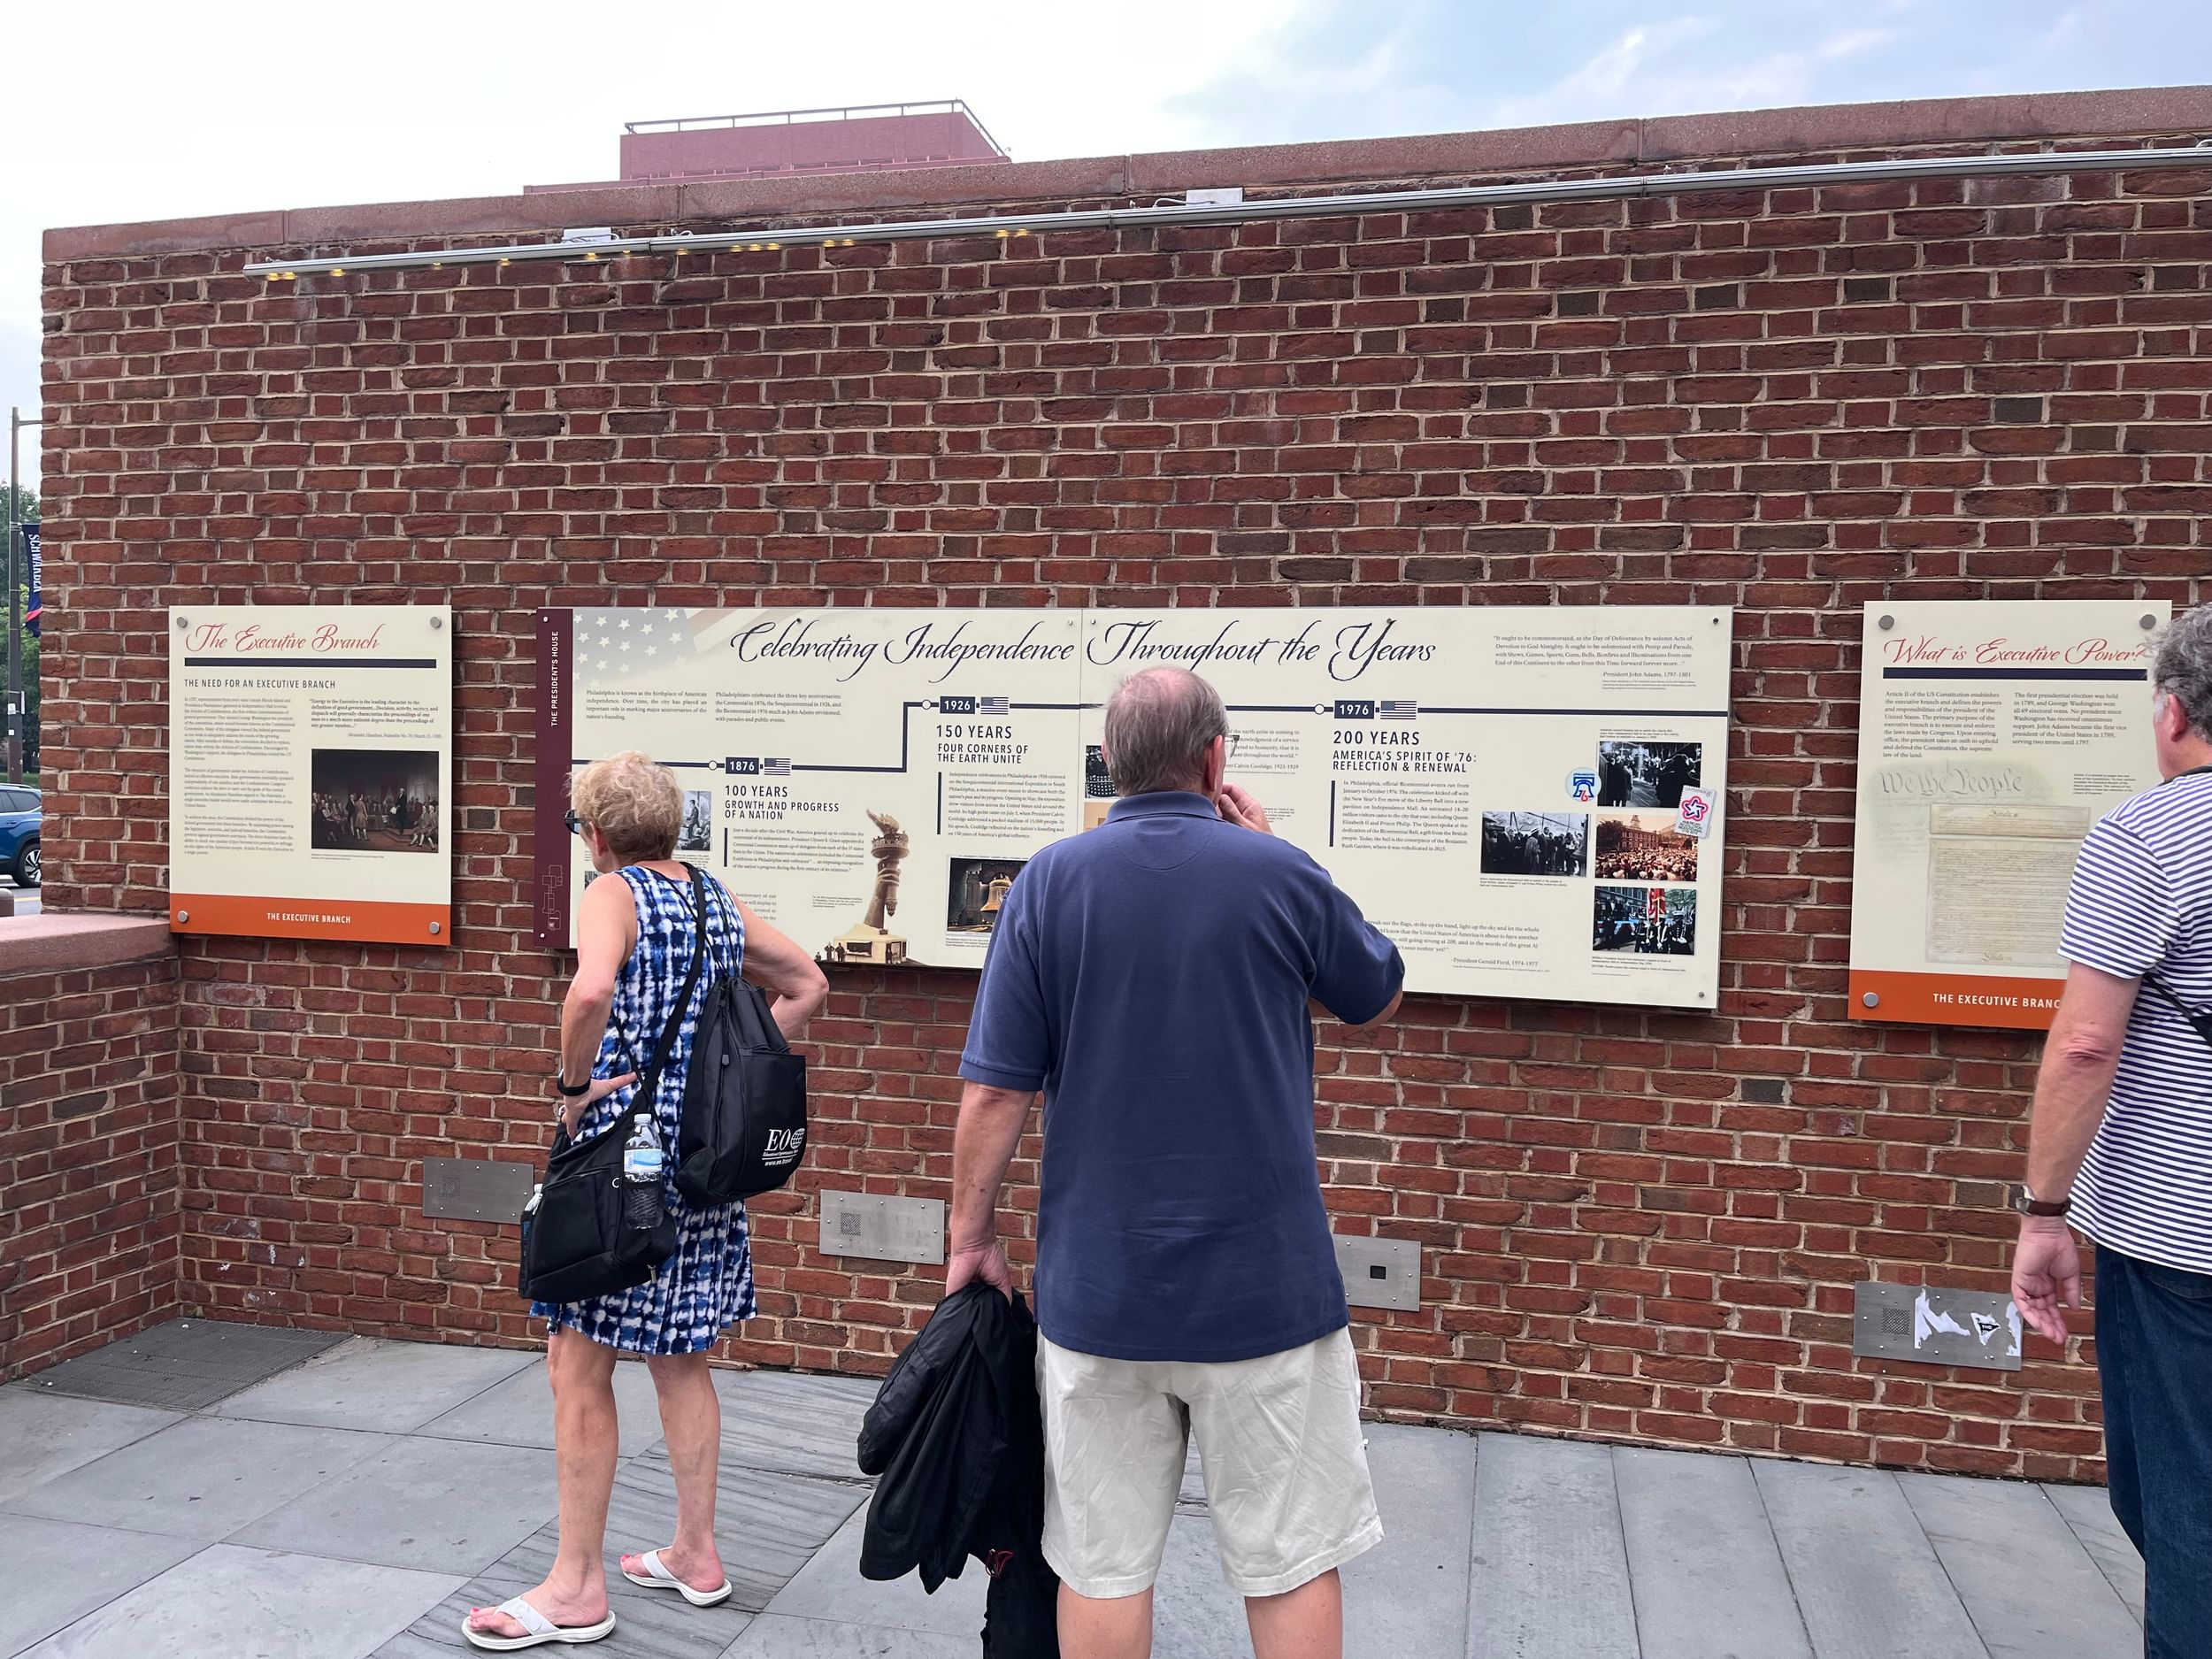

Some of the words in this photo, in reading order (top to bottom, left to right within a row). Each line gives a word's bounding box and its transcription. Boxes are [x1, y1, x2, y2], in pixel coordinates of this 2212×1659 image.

[186, 623, 227, 652] The
[235, 625, 306, 652] Executive
[312, 623, 386, 652] Branch
[730, 618, 879, 682] Celebrating
[884, 620, 1075, 683] Independence
[1087, 620, 1279, 672] Throughout
[1278, 620, 1321, 665] the
[1328, 620, 1436, 681] Years
[1884, 636, 1953, 664] What
[1952, 646, 1967, 661] is
[1976, 638, 2060, 664] Executive
[201, 679, 222, 687] NEED
[257, 680, 299, 688] EXECUTIVE
[302, 680, 336, 689] BRANCH
[945, 700, 970, 710] 1926
[1340, 705, 1369, 715] 1976
[936, 725, 962, 738] 150
[968, 726, 1012, 739] YEARS
[1333, 731, 1363, 744] 200
[1370, 731, 1420, 745] YEARS
[938, 743, 963, 753] FOUR
[967, 744, 1012, 753] CORNERS
[1016, 745, 1028, 754] OF
[938, 754, 955, 762] THE
[959, 754, 989, 763] EARTH
[993, 755, 1022, 764] UNITE
[1333, 751, 1392, 761] AMERICA'S
[1397, 752, 1431, 762] SPIRIT
[1436, 752, 1450, 762] OF
[730, 761, 755, 772] 1876
[1333, 761, 1398, 772] REFLECTION
[1403, 763, 1410, 772] &
[1414, 763, 1466, 773] RENEWAL
[725, 785, 746, 797] 100
[751, 786, 788, 798] YEARS
[725, 800, 765, 810] GROWTH
[768, 801, 787, 810] AND
[791, 801, 839, 812] PROGRESS
[725, 810, 736, 819] OF
[739, 810, 745, 819] A
[749, 810, 783, 820] NATION
[283, 913, 319, 922] EXECUTIVE
[322, 915, 351, 924] BRANCH
[1933, 993, 1953, 1003] THE
[1958, 995, 2018, 1007] EXECUTIVE
[2022, 998, 2061, 1009] BRANC
